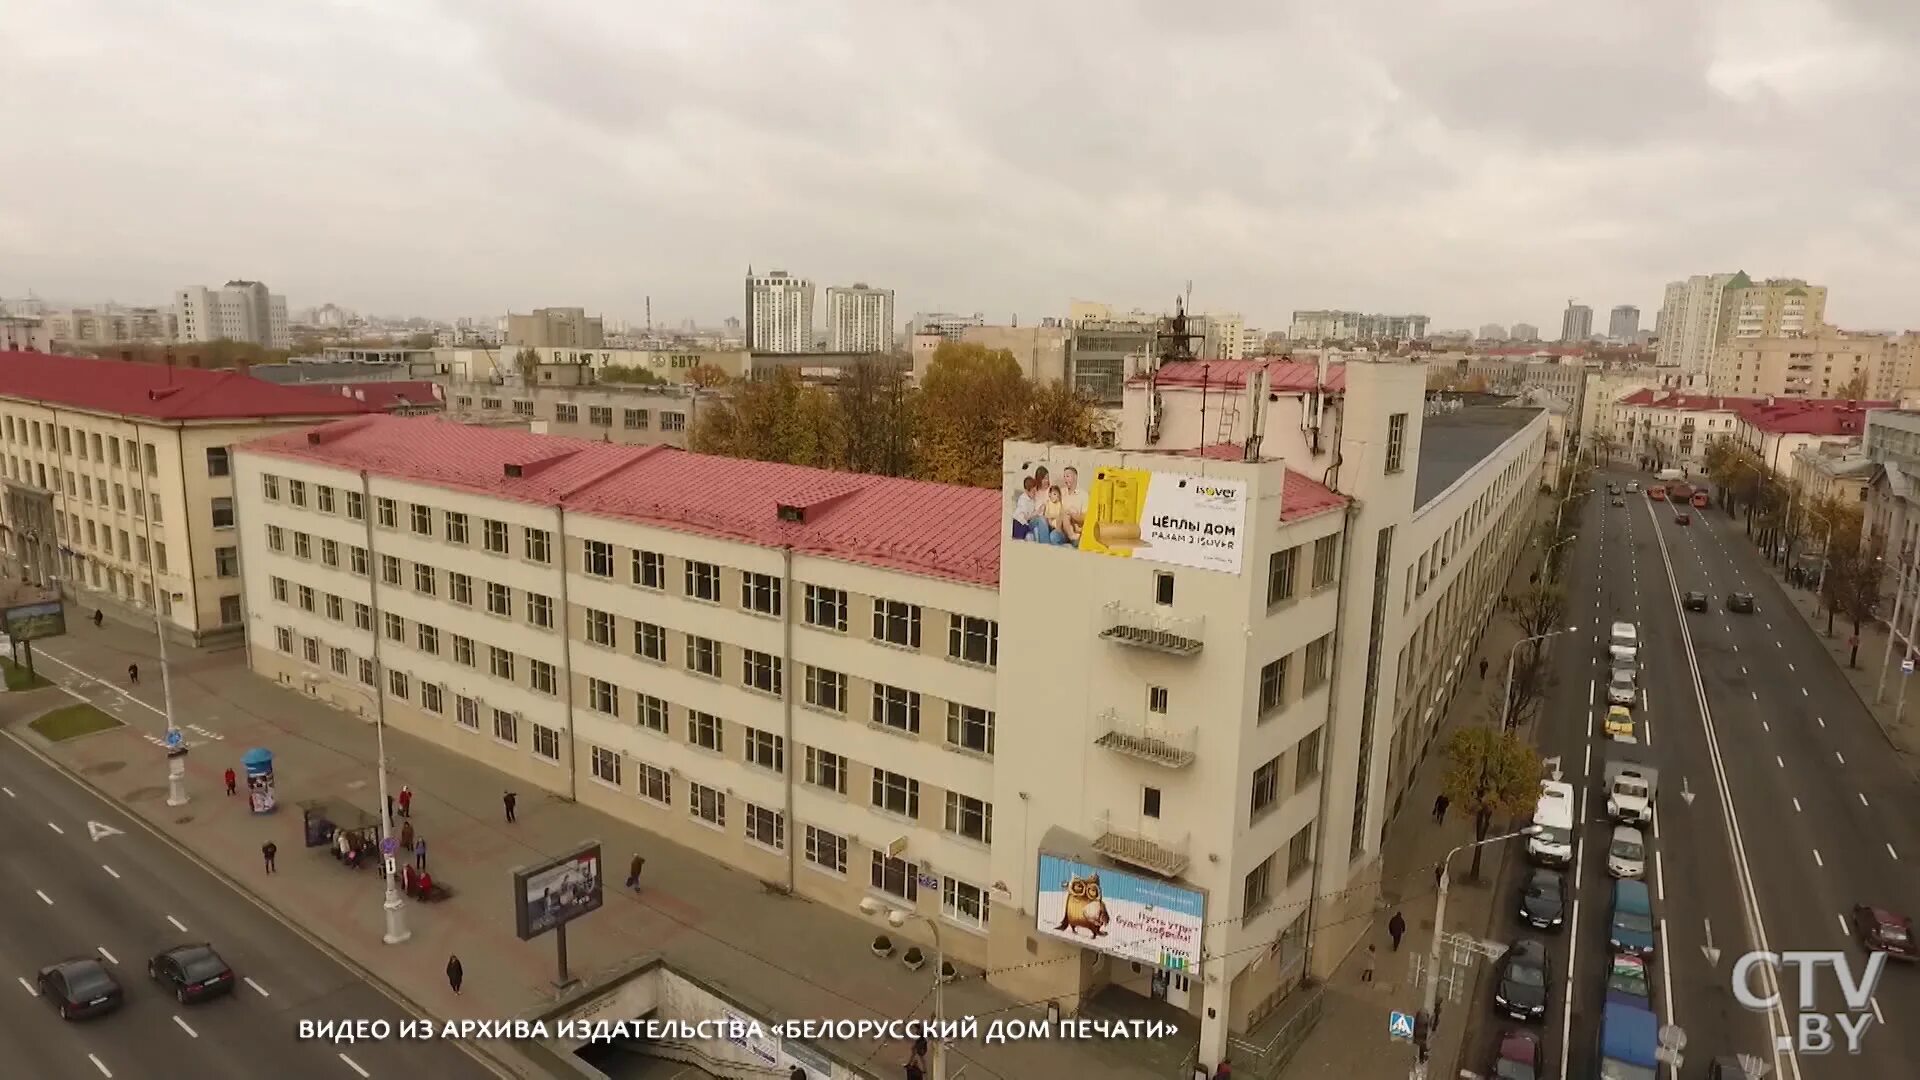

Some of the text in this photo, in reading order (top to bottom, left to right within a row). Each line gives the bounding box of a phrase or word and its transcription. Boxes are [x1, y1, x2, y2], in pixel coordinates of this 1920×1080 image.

[1195, 485, 1237, 498] isover
[1152, 515, 1236, 537] ЦЁПЛЫ ДОМ
